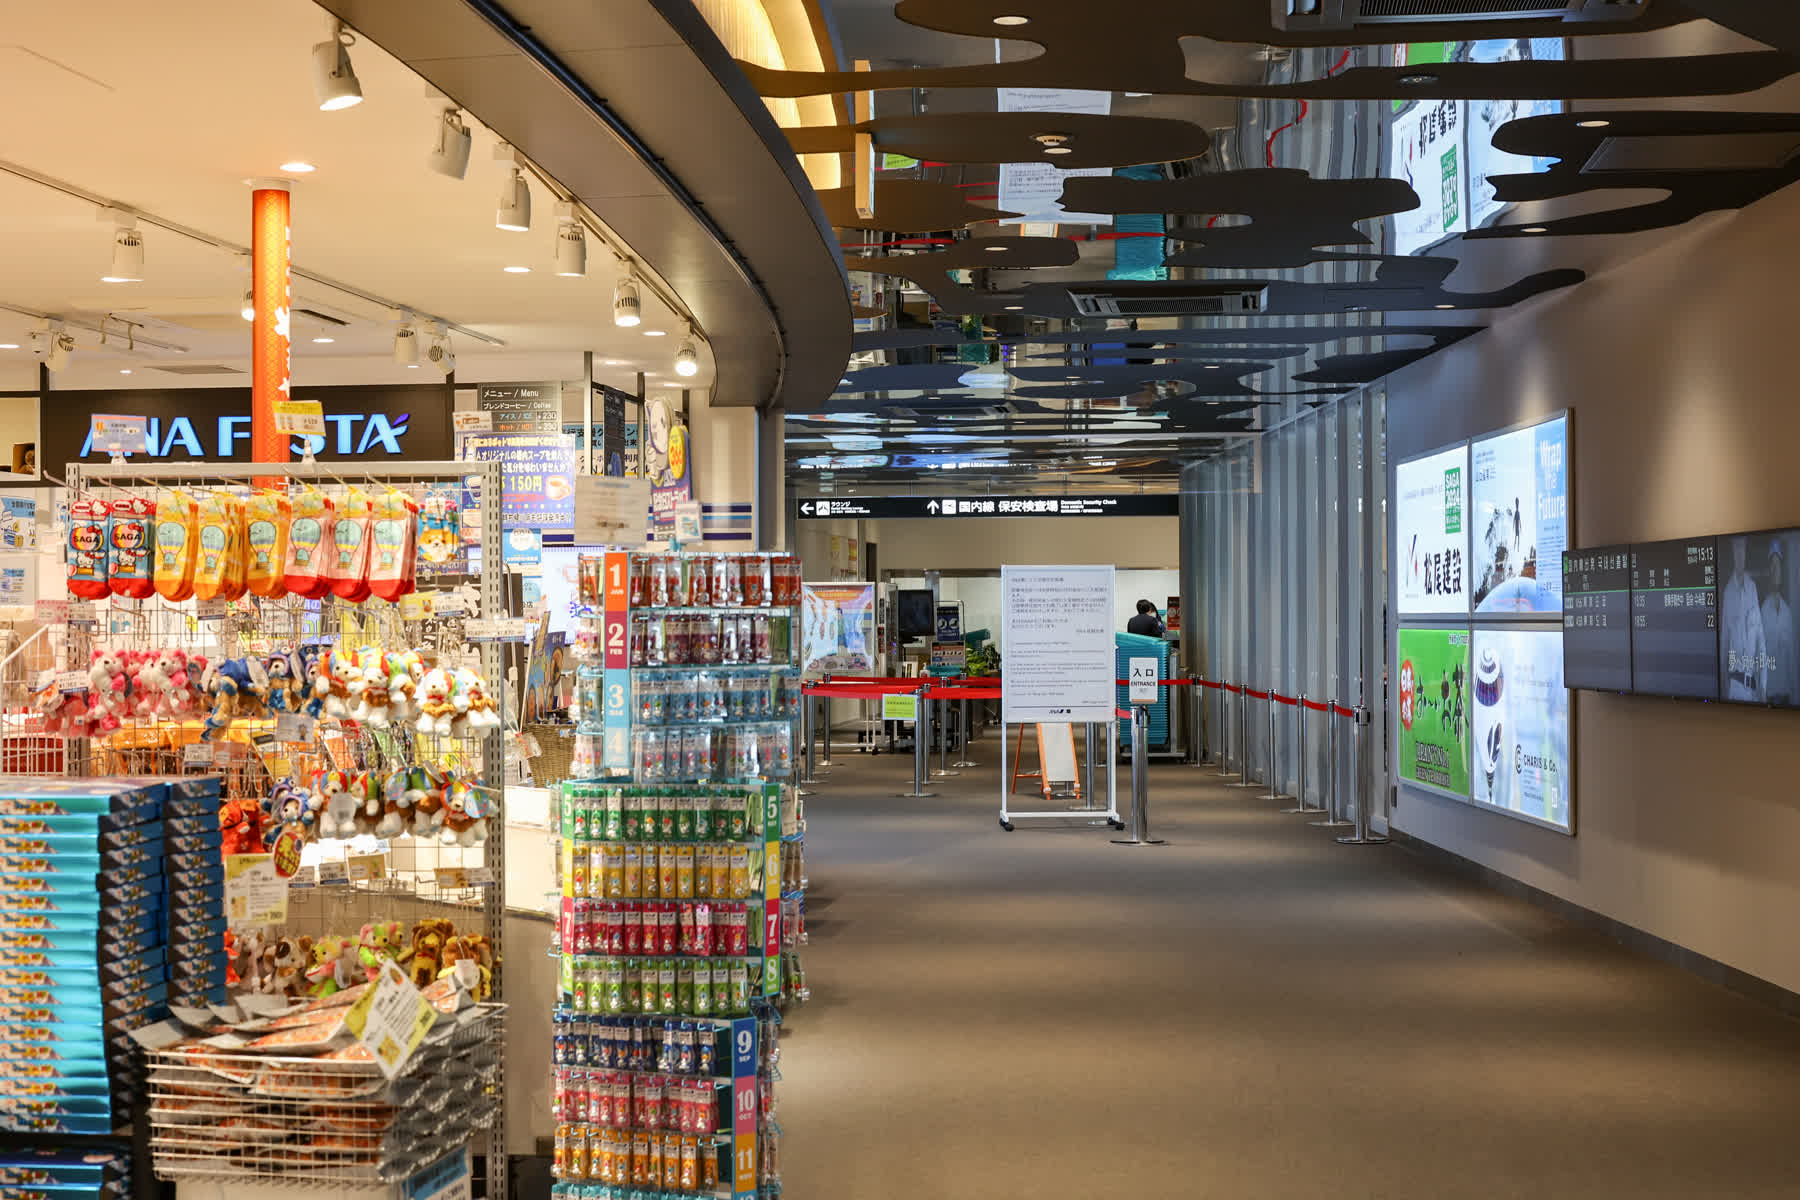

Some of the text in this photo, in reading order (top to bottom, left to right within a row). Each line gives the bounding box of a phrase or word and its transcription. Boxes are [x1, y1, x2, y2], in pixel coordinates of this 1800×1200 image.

[484, 390, 512, 398] メニュー
[520, 389, 539, 397] Menu
[217, 413, 411, 458] FSTA
[1539, 440, 1562, 472] Wrap
[1445, 471, 1460, 488] SAGA
[958, 501, 995, 513] 国内線
[997, 500, 1059, 513] 保安検査場
[1538, 492, 1565, 521] Future
[73, 535, 98, 543] SAGA
[115, 533, 140, 541] SAGA
[1697, 547, 1714, 561] 15:13
[610, 563, 620, 587] 1
[1423, 547, 1462, 595] 松尾建設
[1707, 592, 1714, 606] 22
[1707, 614, 1714, 628] 22
[608, 623, 624, 647] 2
[1133, 668, 1154, 677] 入口
[608, 684, 624, 708] 3
[1523, 753, 1558, 773] CHARIS & Co.
[767, 796, 777, 819] 5
[768, 854, 777, 877] 6
[767, 914, 777, 937] 7
[767, 959, 777, 982] 8
[737, 1031, 752, 1054] 9
[737, 1089, 754, 1113] 10
[736, 1148, 753, 1170] 11
